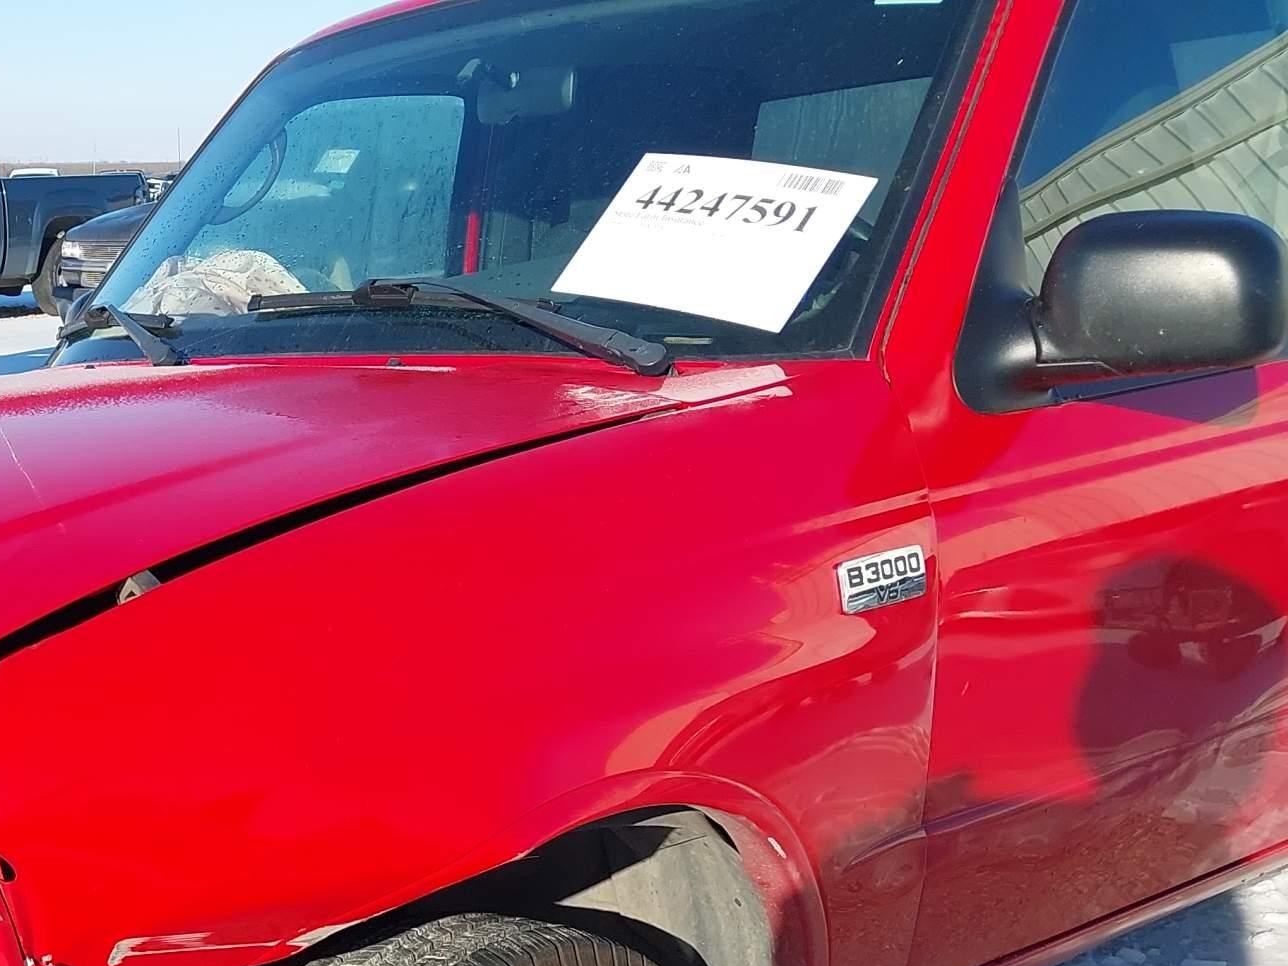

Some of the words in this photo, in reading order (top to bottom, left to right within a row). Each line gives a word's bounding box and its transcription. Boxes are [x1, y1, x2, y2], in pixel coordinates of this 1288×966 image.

[635, 185, 817, 232] 44247591
[847, 552, 921, 588] B3000
[876, 582, 900, 603] V6
